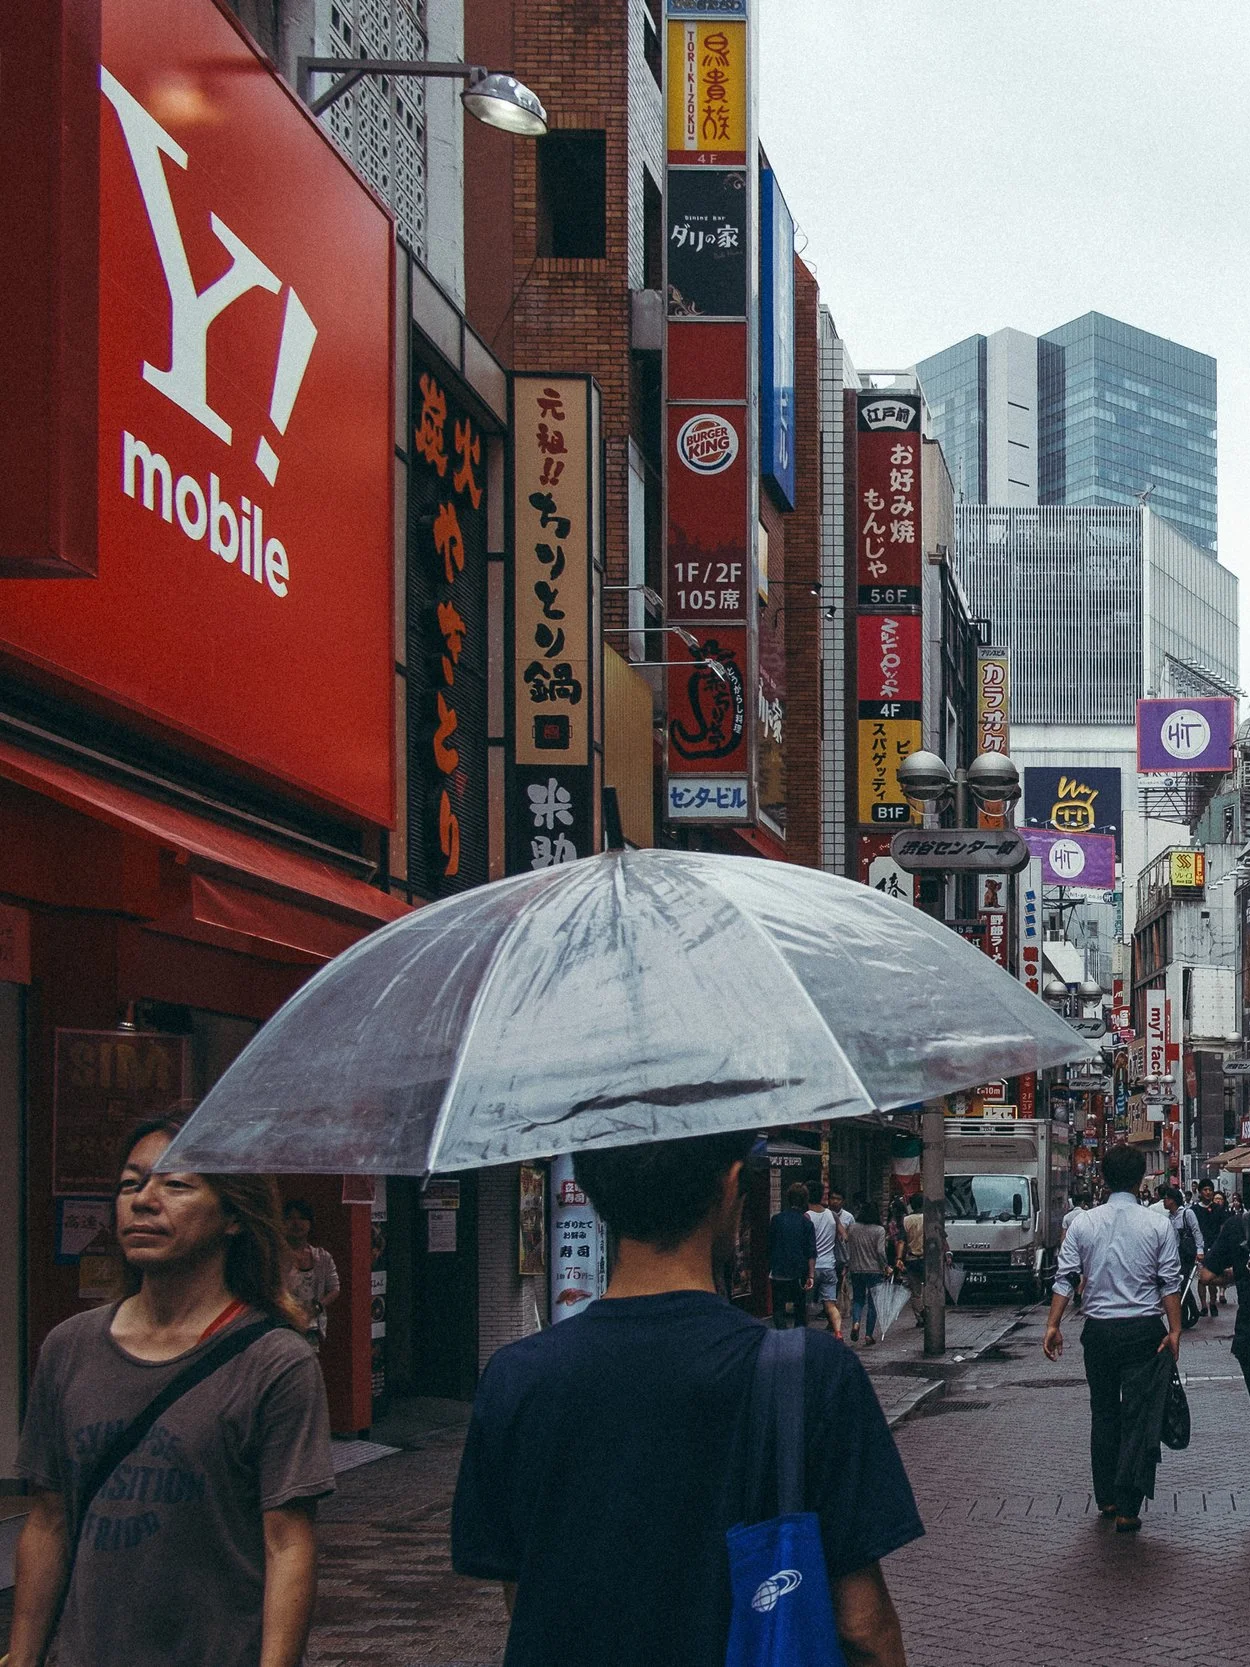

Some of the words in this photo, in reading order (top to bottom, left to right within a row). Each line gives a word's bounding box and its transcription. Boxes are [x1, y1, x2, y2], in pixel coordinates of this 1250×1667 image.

[687, 31, 695, 135] TORIKIZOKU
[702, 32, 730, 140] 鳥貴族
[671, 224, 739, 252] ダリの家
[686, 426, 728, 447] BURGER
[688, 436, 730, 461] KING
[890, 443, 915, 544] お好み焼
[123, 430, 290, 599] mobile
[863, 488, 888, 579] もんじゃ
[674, 562, 742, 584] 1F/2F
[677, 589, 741, 611] 105席
[880, 704, 901, 718] 4F
[670, 786, 748, 809] センタービル
[877, 807, 904, 820] B1F
[900, 840, 1020, 856] 渋谷センター街
[990, 914, 1005, 963] 野郎ラーメ
[556, 1220, 593, 1229] にぎりたて
[560, 1245, 590, 1259] 寿司
